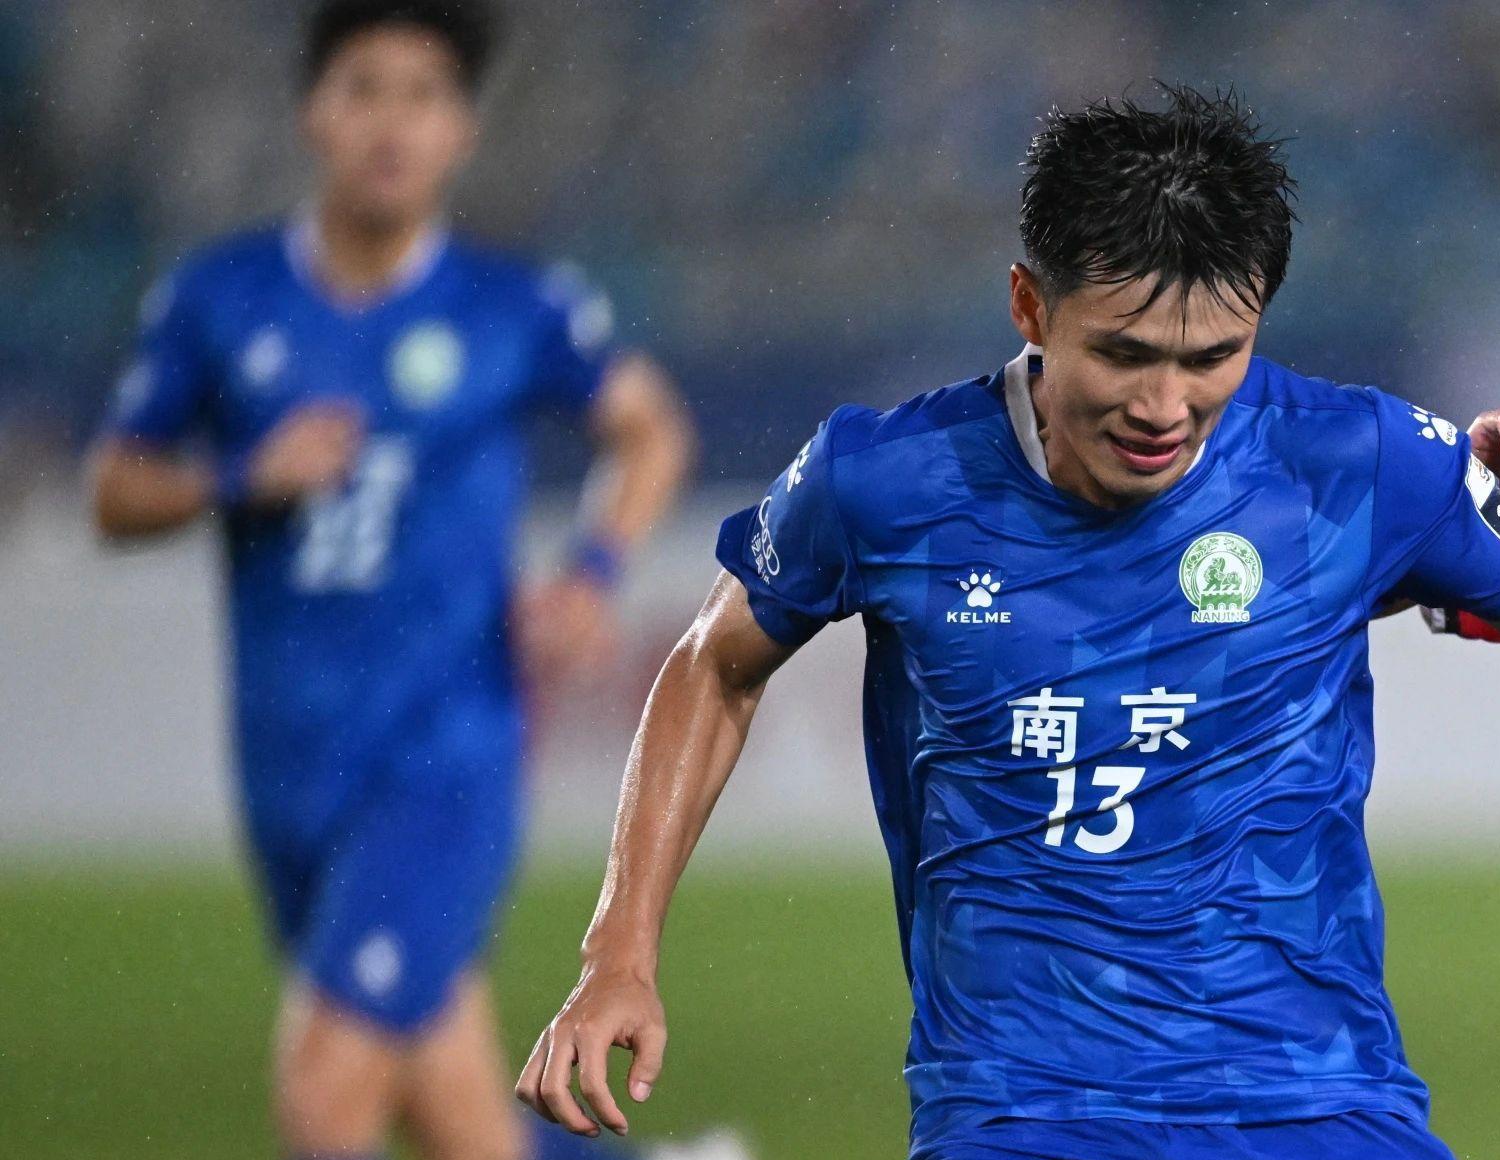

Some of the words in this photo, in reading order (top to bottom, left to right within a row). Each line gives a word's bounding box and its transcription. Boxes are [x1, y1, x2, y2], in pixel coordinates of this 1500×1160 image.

[946, 611, 1012, 624] KELME
[1191, 610, 1250, 623] NANJING
[1008, 686, 1198, 763] 南京
[1044, 765, 1146, 854] 13
